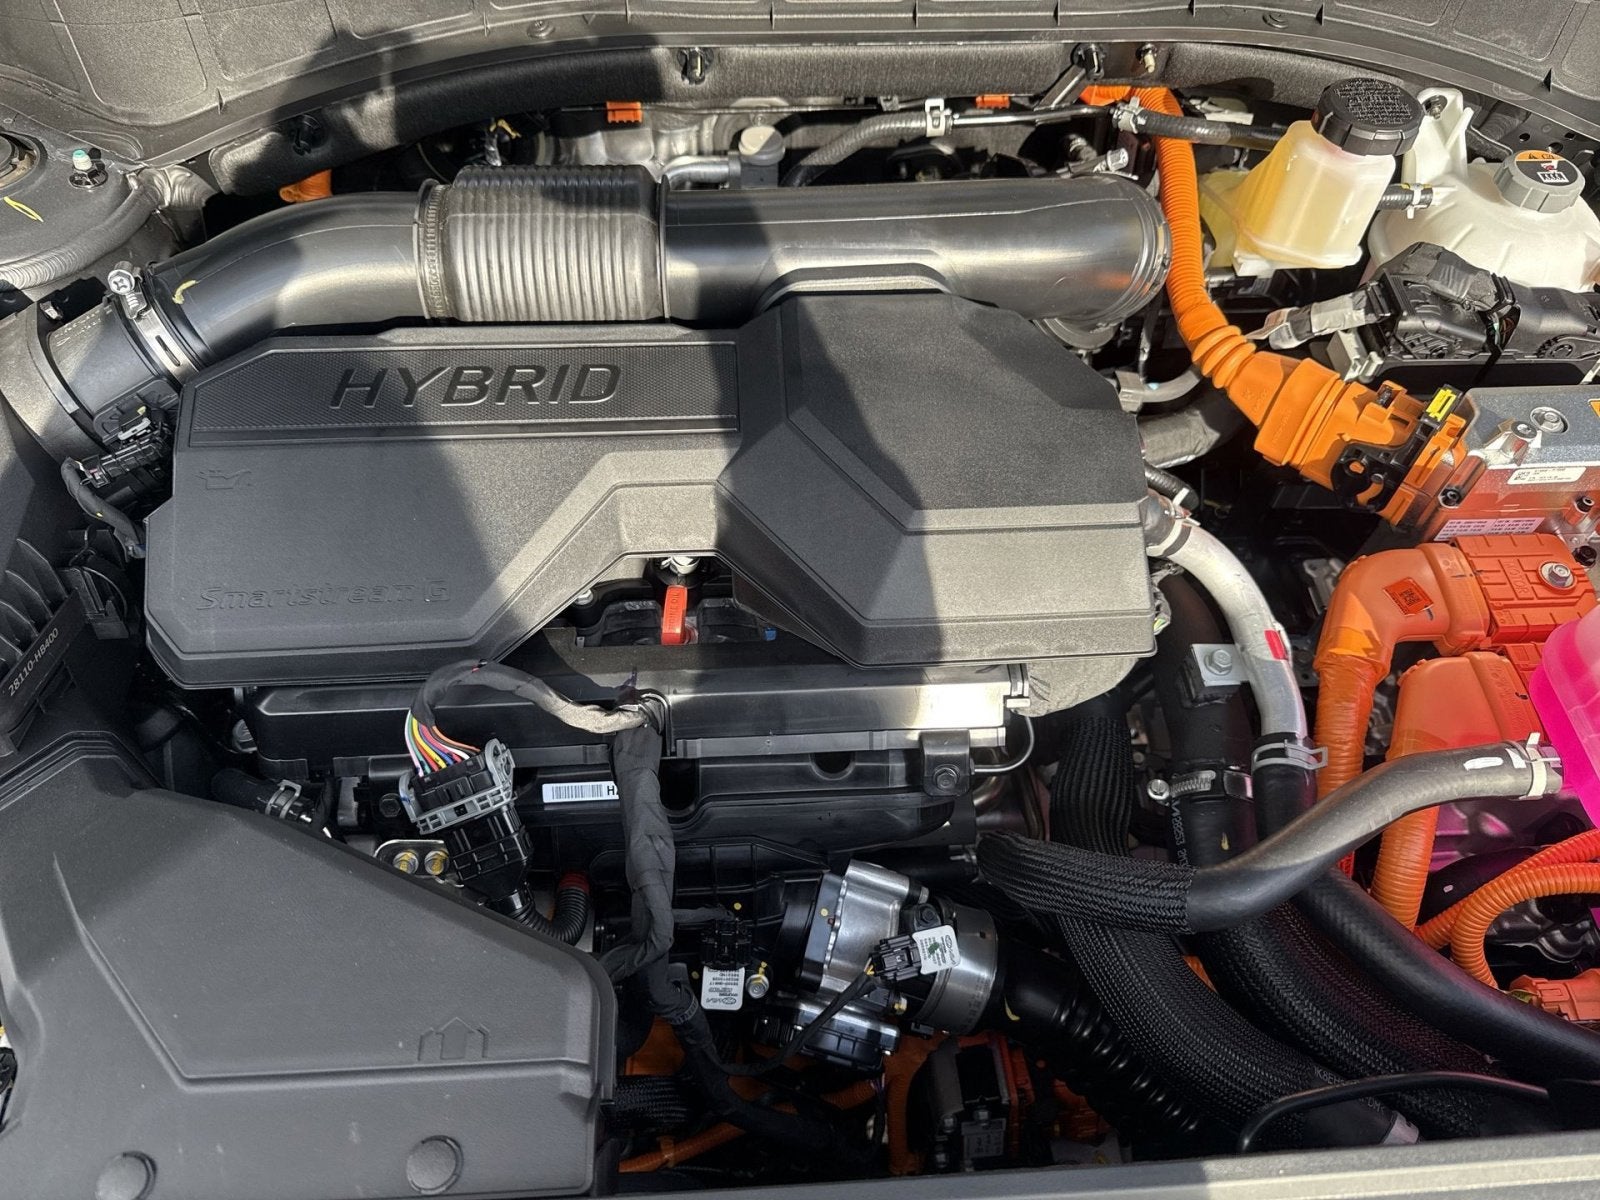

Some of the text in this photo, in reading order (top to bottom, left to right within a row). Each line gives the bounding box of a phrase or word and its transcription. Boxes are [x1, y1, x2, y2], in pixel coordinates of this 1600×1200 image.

[329, 363, 622, 410] HYBRID
[196, 578, 451, 610] Smartstream G
[8, 627, 59, 697] 28110-HB400
